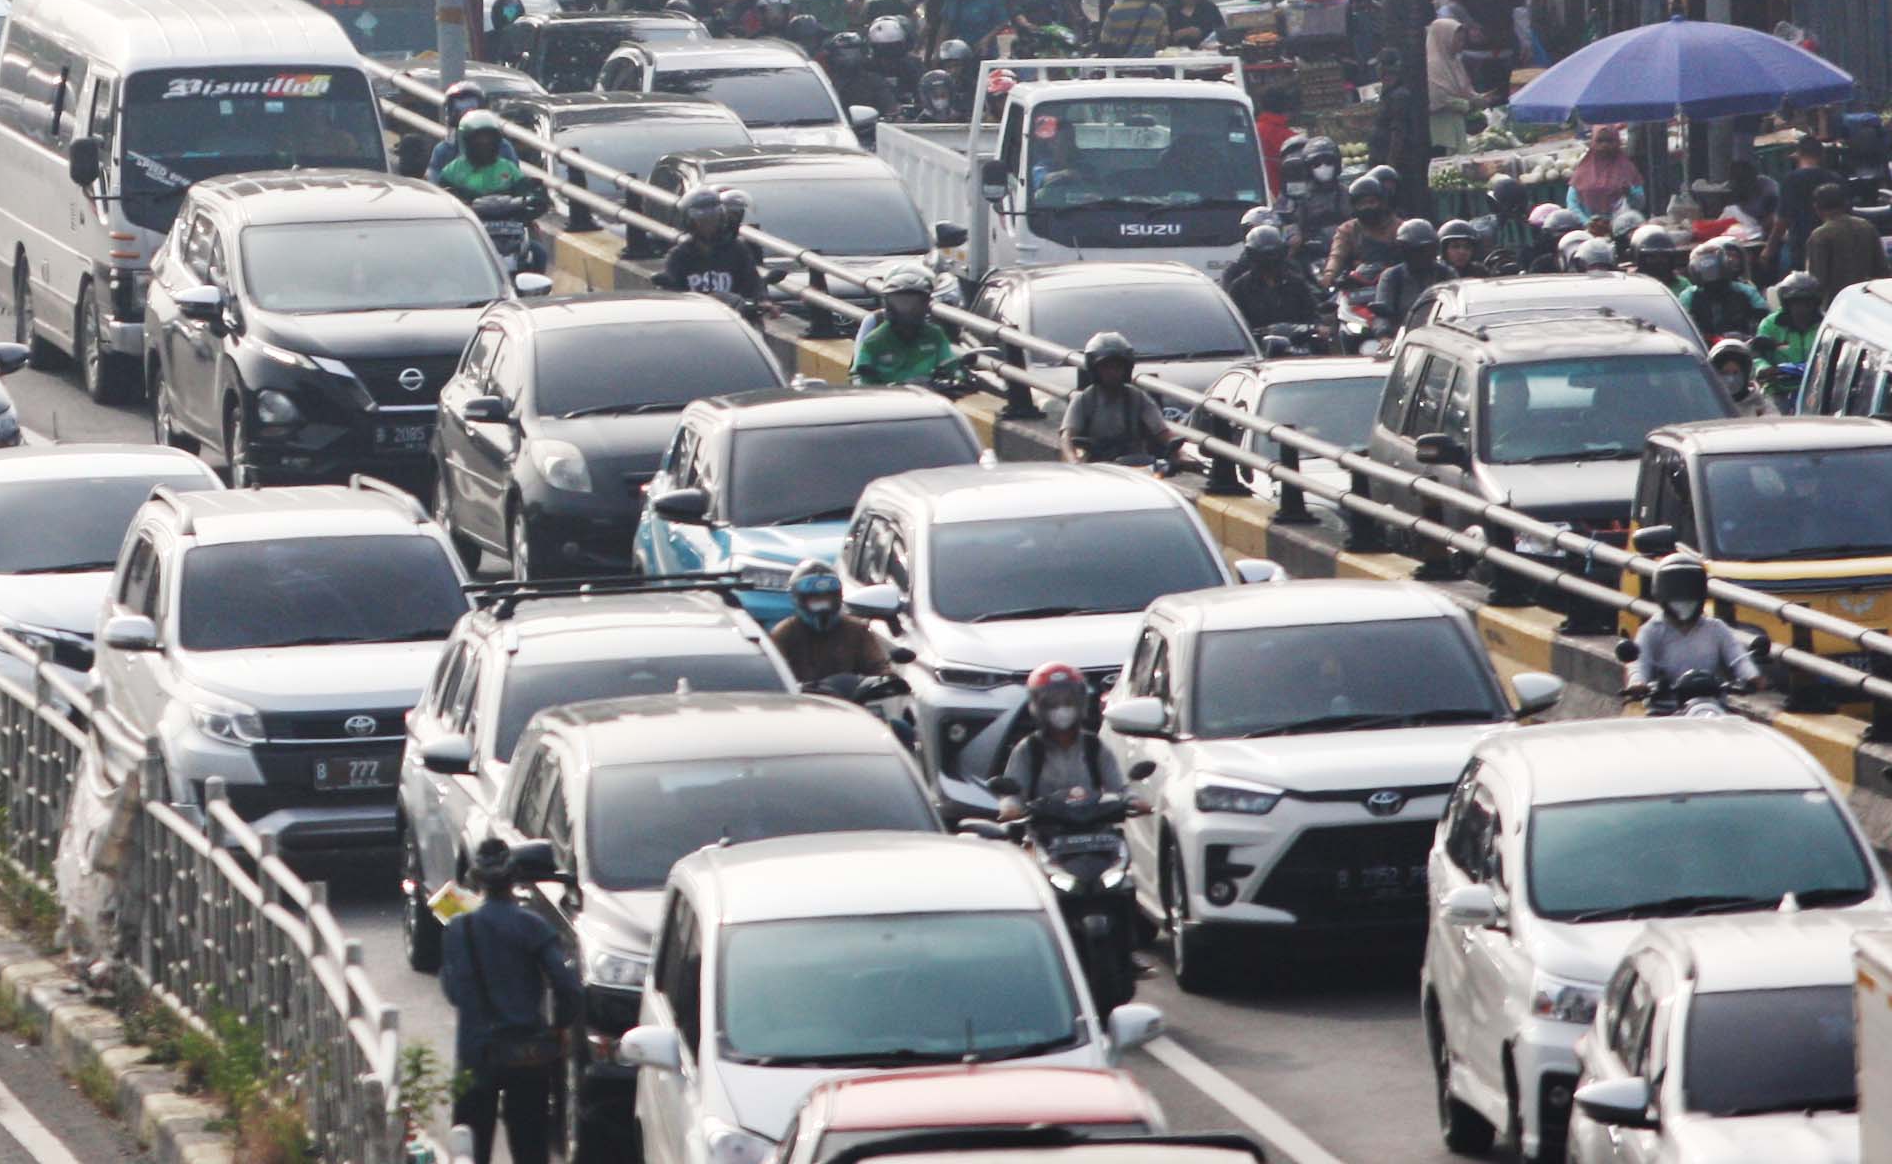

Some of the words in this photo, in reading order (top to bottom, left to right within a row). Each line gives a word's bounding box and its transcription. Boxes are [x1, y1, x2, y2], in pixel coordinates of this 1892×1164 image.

[1120, 223, 1181, 236] ISUZU
[316, 762, 327, 780] B
[349, 760, 380, 777] 777
